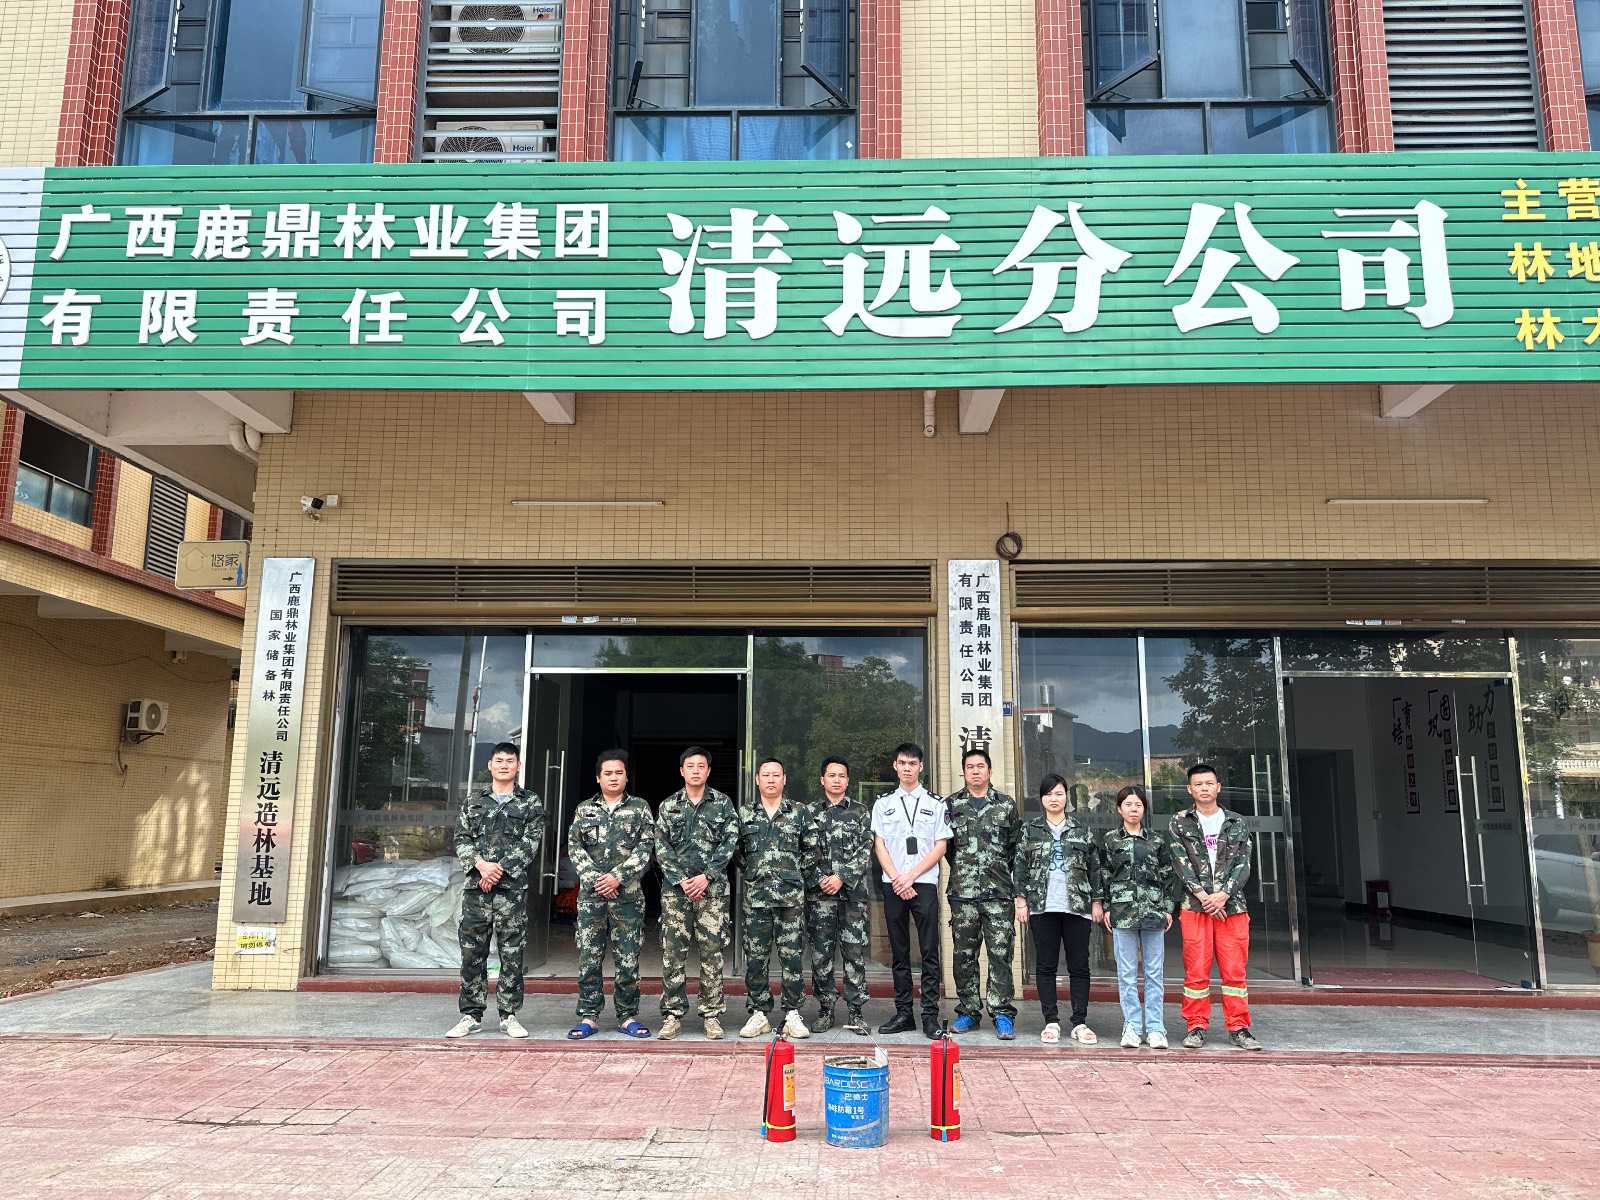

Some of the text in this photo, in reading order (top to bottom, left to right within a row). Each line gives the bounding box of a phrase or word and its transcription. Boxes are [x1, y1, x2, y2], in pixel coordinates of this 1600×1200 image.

[512, 144, 535, 152] Haier
[49, 202, 609, 261] 广西鹿鼎林业集团
[1501, 177, 1600, 220] 主营
[656, 199, 1455, 339] 清远分公司
[1507, 241, 1600, 284] 林地
[39, 287, 606, 346] 有限责任公司
[262, 609, 282, 701] 国家储备林
[276, 572, 302, 741] 广西鹿鼎林业集团有限责任公司
[958, 573, 975, 707] 有限责任公司
[976, 573, 993, 707] 广西鹿鼎林业集团
[247, 751, 284, 906] 清远造林基地
